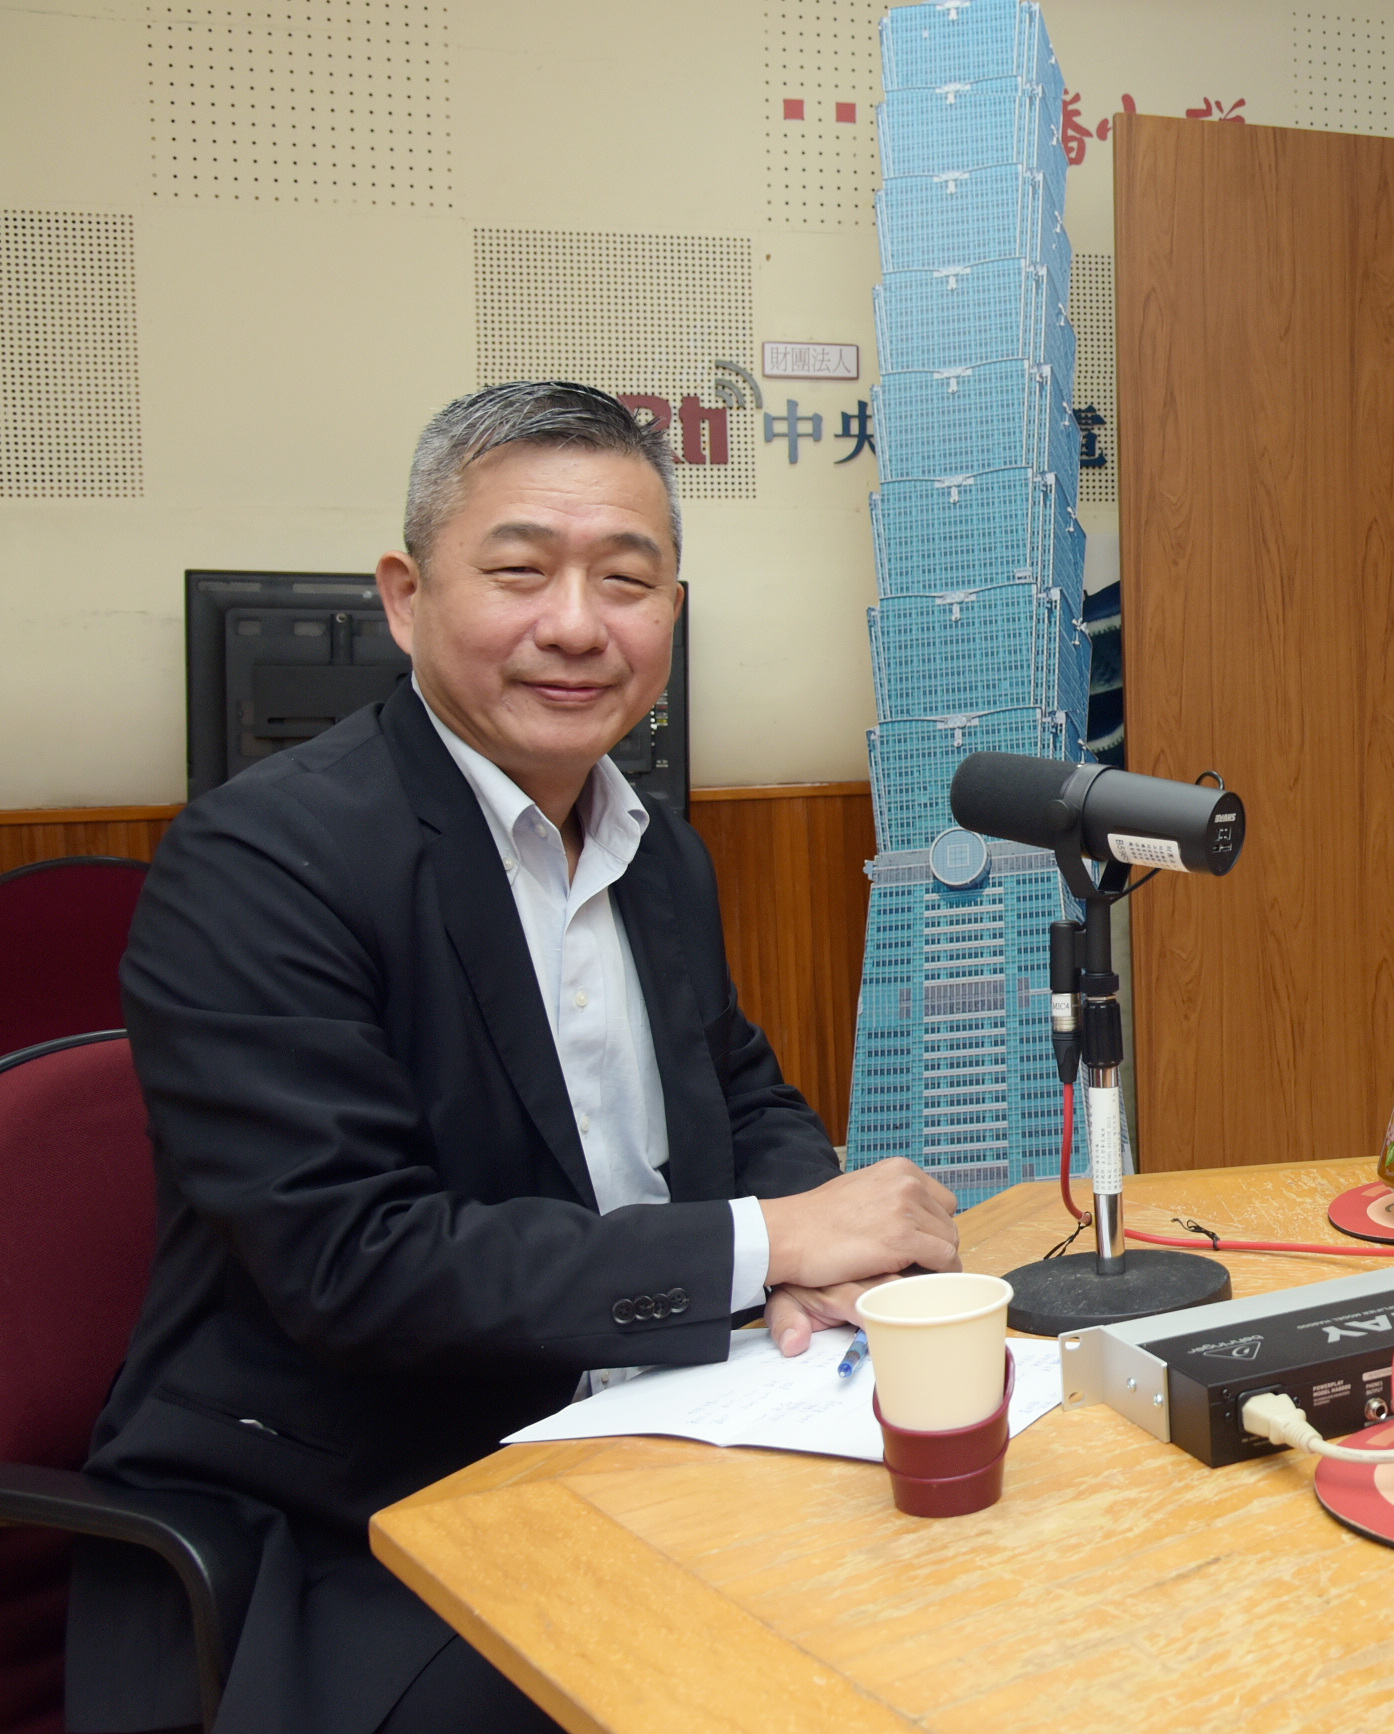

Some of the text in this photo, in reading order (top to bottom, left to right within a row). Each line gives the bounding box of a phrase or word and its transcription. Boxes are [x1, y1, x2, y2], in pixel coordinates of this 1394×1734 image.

[770, 346, 851, 374] 財團法人
[1214, 812, 1237, 823] SHURE
[1052, 1002, 1070, 1010] MIC4
[1187, 1334, 1264, 1354] behringer
